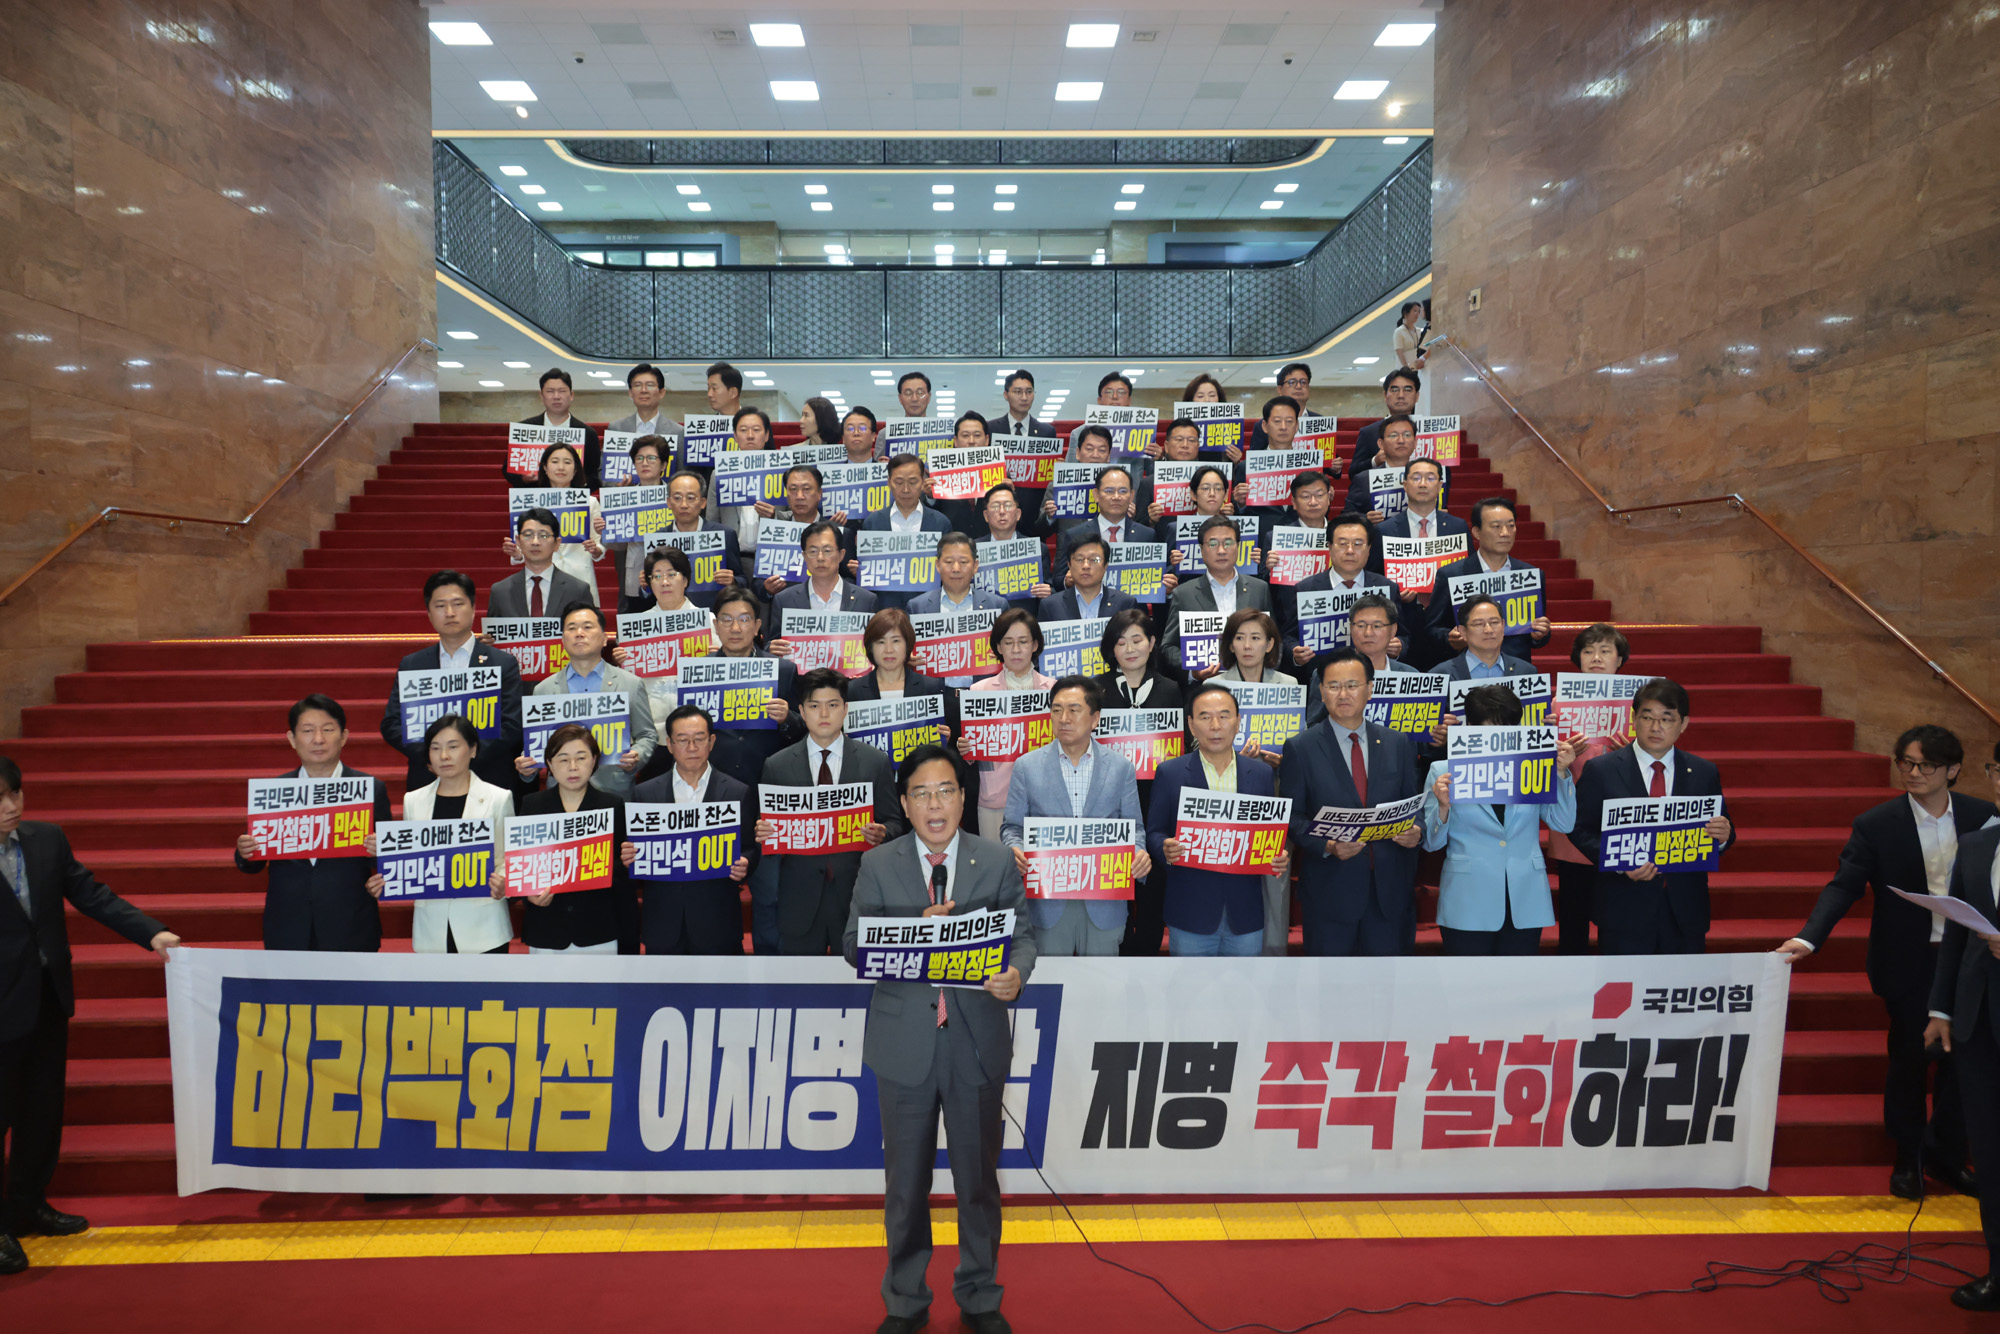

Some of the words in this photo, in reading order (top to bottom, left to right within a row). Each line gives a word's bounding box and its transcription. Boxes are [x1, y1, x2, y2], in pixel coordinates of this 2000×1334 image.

[1088, 410, 1133, 424] 스폰·아빠
[1136, 411, 1156, 424] 찬스
[1210, 404, 1241, 418] 비리의혹
[512, 428, 546, 444] 국민무시
[548, 428, 582, 444] 불량인사
[687, 419, 730, 434] 스폰·아빠
[889, 423, 920, 437] 파도파도
[922, 419, 954, 434] 비리의혹
[1206, 422, 1242, 446] 빵점정부
[1306, 416, 1334, 434] 불량인사
[1423, 416, 1456, 433] 불량인사
[1028, 440, 1060, 454] 불량인사
[1128, 429, 1154, 452] OUT
[1436, 435, 1458, 460] 민심!
[718, 454, 766, 473] 스폰·아빠
[769, 452, 790, 467] 찬스
[792, 450, 816, 464] 도파도
[932, 454, 966, 469] 국민무시
[967, 448, 1000, 466] 불량인사
[1250, 456, 1284, 471] 국민무시
[1286, 450, 1320, 466] 불량인사
[822, 468, 868, 486] 스폰·아빠
[933, 470, 982, 497] 즉각철회가
[1057, 468, 1090, 484] 파도파도
[1158, 468, 1192, 482] 국민무시
[512, 493, 562, 509] 스폰·아빠
[565, 490, 588, 504] 찬스
[604, 493, 638, 508] 파도파도
[640, 487, 668, 504] 비리의
[719, 475, 761, 504] 김민석
[822, 489, 863, 516] 김민석
[1056, 489, 1089, 516] 도덕성
[560, 510, 588, 538] OUT
[605, 514, 636, 540] 도덕성
[760, 526, 802, 543] 스폰·아
[699, 533, 722, 548] 찬스
[860, 537, 912, 554] 스폰·아빠
[916, 534, 941, 551] 찬스
[1000, 538, 1036, 560] 비리의혹
[1126, 544, 1162, 562] 비리의혹
[1276, 532, 1314, 548] 국민무시
[1386, 542, 1422, 558] 국민무시
[1424, 535, 1462, 555] 불량인사
[860, 558, 904, 588] 김민석
[909, 556, 936, 584] OUT
[998, 562, 1040, 595] 빵점정부
[1120, 567, 1162, 596] 빵점정부
[1386, 560, 1438, 590] 즉각철회가
[1453, 577, 1506, 603] 스폰·아빠
[1510, 571, 1538, 590] 찬스
[622, 620, 662, 638] 국민무시
[666, 610, 706, 634] 불량인사
[786, 616, 826, 633] 국민무시
[830, 614, 870, 633] 불량인사
[1506, 594, 1538, 628] OUT
[487, 622, 528, 642] 국민무시
[532, 622, 563, 638] 불량인
[915, 620, 954, 638] 국민무시
[958, 614, 998, 634] 불량인사
[1184, 616, 1223, 633] 파도파도
[916, 640, 972, 674] 즉각철회가
[1044, 652, 1078, 678] 도덕성
[1186, 638, 1220, 668] 도덕성
[404, 669, 468, 699] 스폰·아빠
[472, 668, 498, 690] 찬스
[682, 662, 726, 684] 파도파도
[728, 660, 774, 679] 비리의혹
[1371, 678, 1398, 694] 파도
[1400, 676, 1444, 694] 비리의혹
[1257, 686, 1302, 706] 비리의혹
[1518, 676, 1547, 697] 찬스
[1561, 680, 1609, 698] 국민무시
[467, 696, 498, 730] OUT
[526, 698, 592, 724] 스폰·아빠
[597, 694, 626, 714] 찬스
[848, 706, 893, 728] 파도파도
[896, 698, 939, 721] 비리의혹
[964, 698, 1007, 718] 국민무시
[1135, 710, 1179, 732] 불량인사
[1388, 702, 1440, 734] 빵점정부
[1558, 706, 1626, 738] 즉각철회가
[964, 722, 1026, 757] 즉각철회가
[1451, 730, 1522, 756] 스폰·아빠
[1526, 728, 1554, 750] 찬스
[1454, 760, 1514, 800] 김민석
[1520, 758, 1554, 795] OUT
[254, 785, 309, 810] 국민무시
[313, 780, 367, 805] 불량인사
[764, 792, 813, 812] 국민무시
[817, 785, 867, 808] 불량인사
[630, 807, 700, 833] 스폰·아빠
[705, 804, 736, 826] 찬스
[1183, 797, 1235, 821] 국민무시
[1236, 798, 1286, 822] 불량인사
[1320, 810, 1375, 824] 파도파도
[1607, 803, 1659, 827] 파도파도
[1664, 798, 1716, 822] 비리의혹
[252, 814, 331, 857] 즉각철회가
[334, 809, 370, 848] 민심!
[380, 824, 454, 852] 스폰·아빠
[458, 821, 490, 844] 찬스
[510, 821, 560, 846] 국민무시
[563, 811, 608, 840] 불량인사
[1028, 826, 1078, 848] 국민무시
[1081, 822, 1130, 846] 불량인사
[1308, 824, 1360, 842] 도덕성
[634, 838, 692, 876] 김민석
[698, 832, 737, 871] OUT
[1178, 826, 1250, 866] 즉각철회가
[1250, 830, 1284, 864] 민심!
[1604, 832, 1652, 868] 도덕성
[1654, 827, 1714, 866] 빵점정부
[383, 855, 445, 897] 김민석
[451, 850, 490, 890] OUT
[508, 847, 578, 892] 즉각철회가
[580, 840, 610, 881] 민심!
[1026, 854, 1096, 894] 즉각철회가
[1100, 852, 1132, 890] 민심!
[864, 924, 934, 944] 파도파도
[939, 913, 1006, 942] 비리의혹
[864, 952, 924, 980] 도덕성
[927, 944, 1004, 981] 빵점정부
[1642, 984, 1754, 1015] 국민의힘
[232, 1000, 617, 1152] 비리백화점
[640, 1006, 867, 1152] 이재명
[1081, 1040, 1238, 1150] 지명
[1254, 1040, 1409, 1150] 즉각
[1422, 1033, 1750, 1150] 철회하라!
